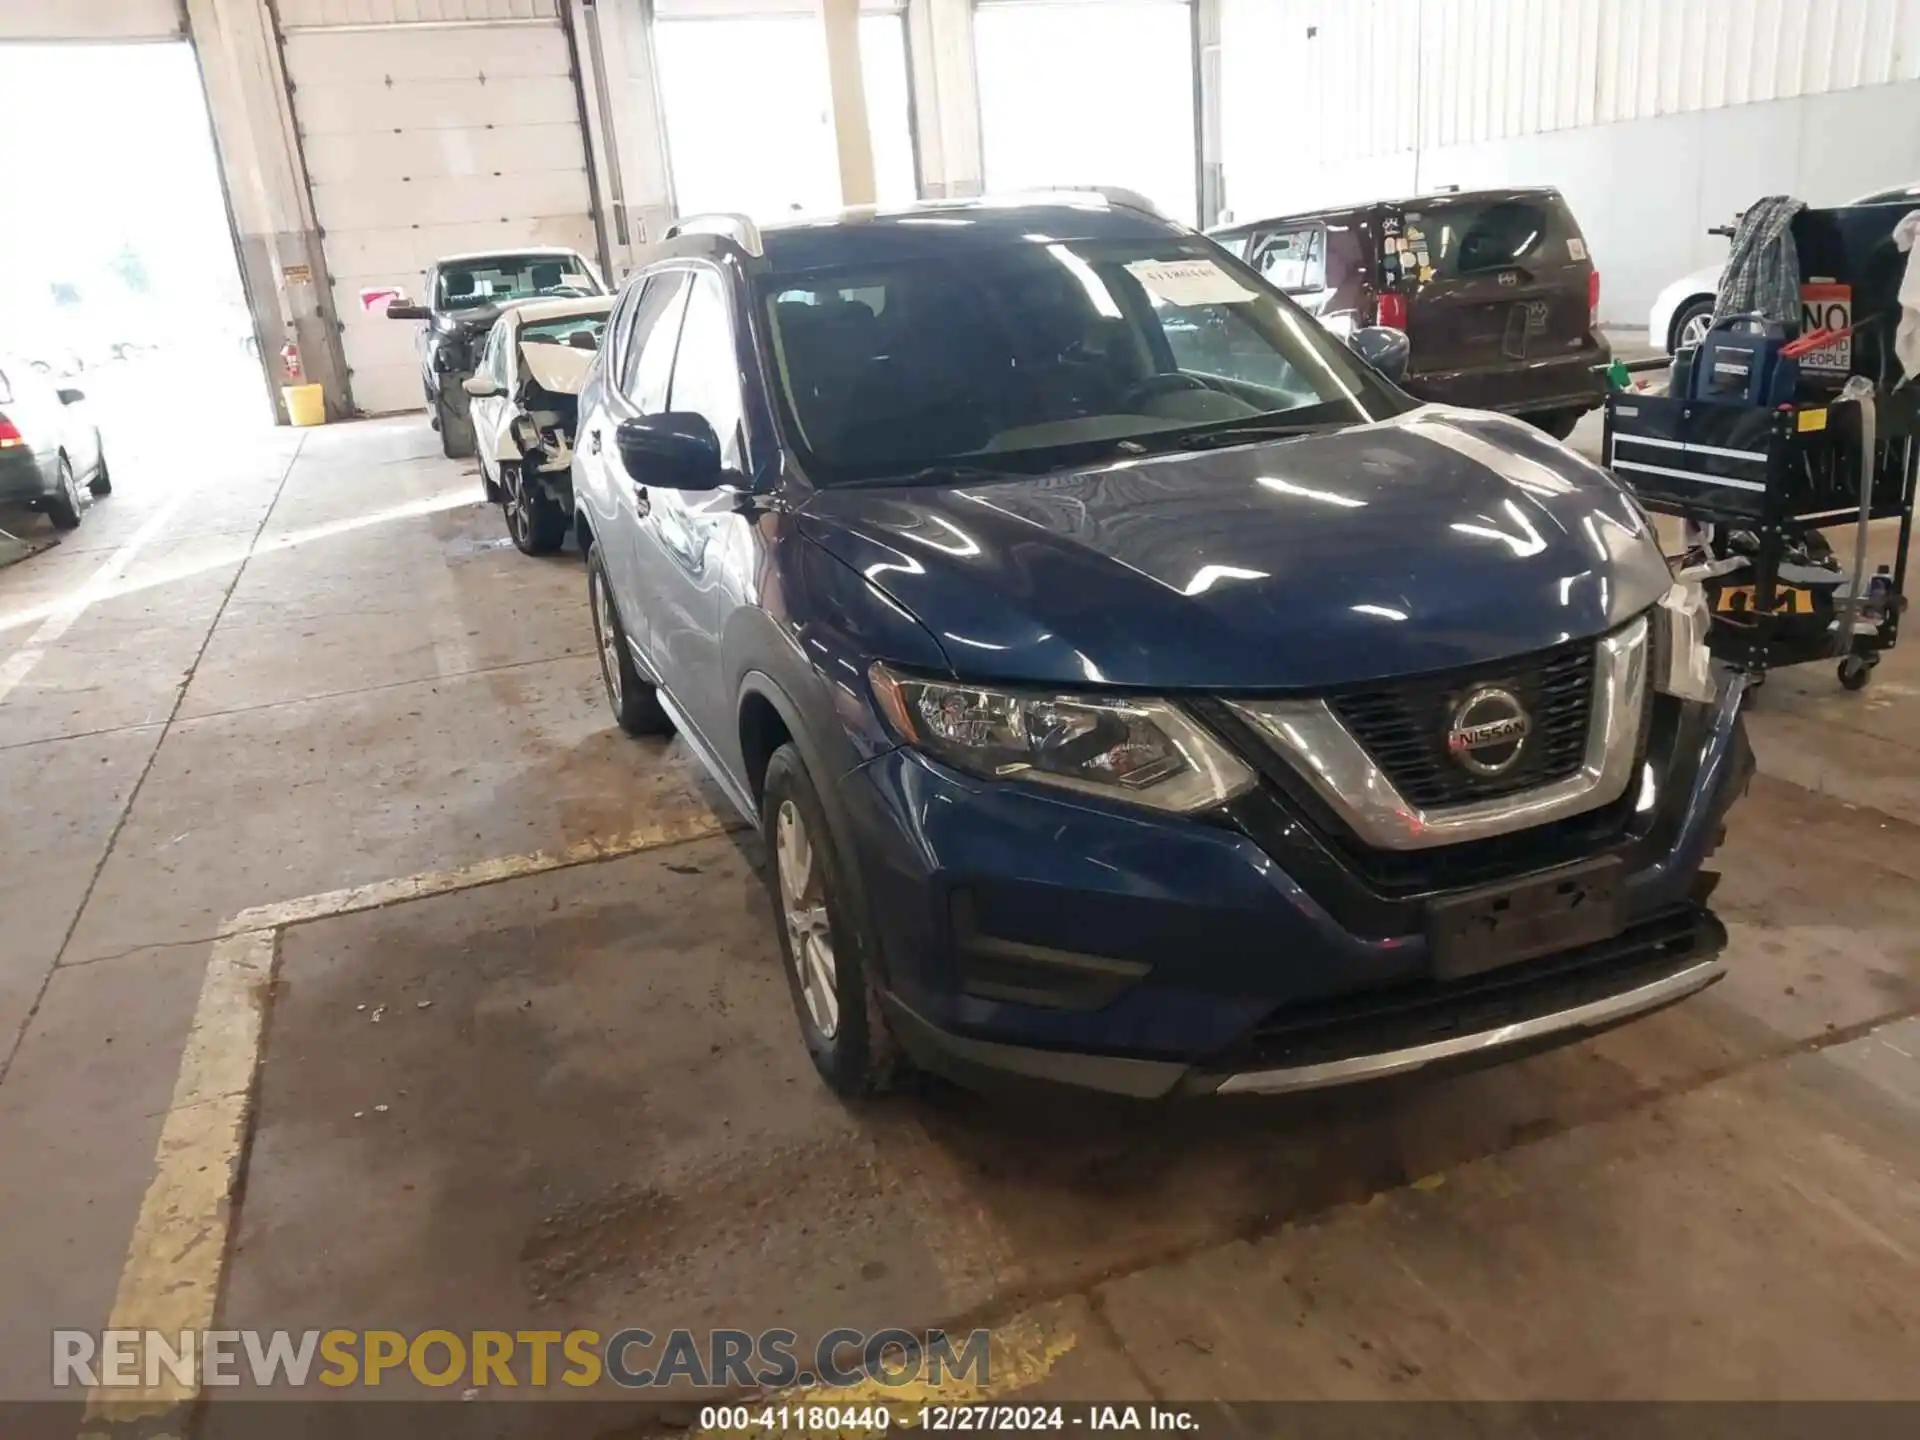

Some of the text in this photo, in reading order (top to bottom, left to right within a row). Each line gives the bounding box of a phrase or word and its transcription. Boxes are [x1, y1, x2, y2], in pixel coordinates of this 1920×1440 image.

[1802, 303, 1848, 333] NO
[1801, 352, 1848, 366] PEOPLE
[1460, 721, 1526, 744] NISSAN
